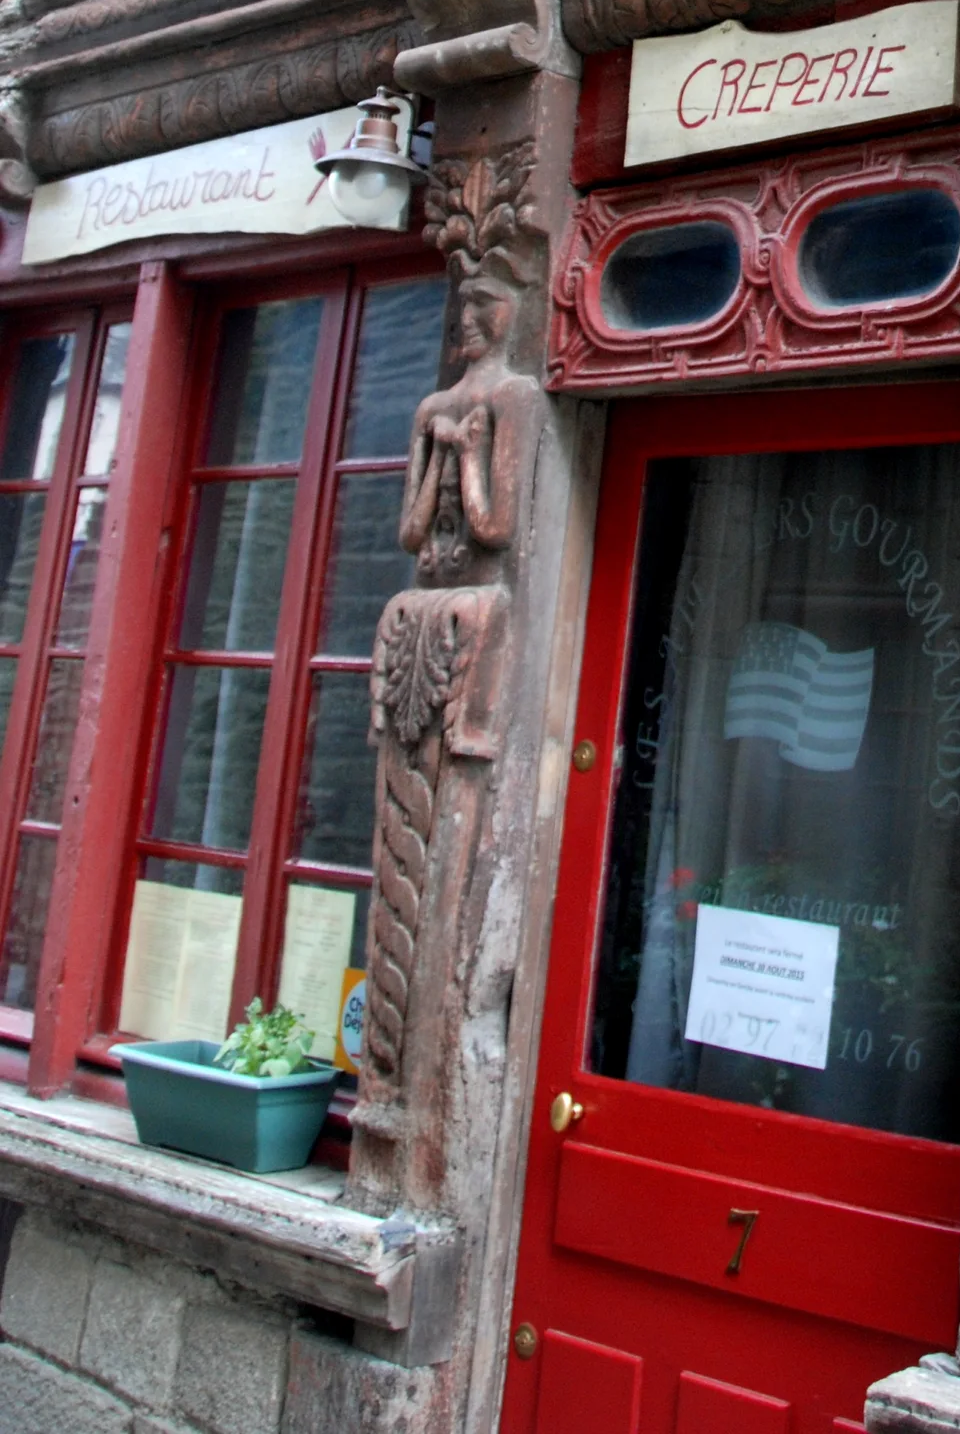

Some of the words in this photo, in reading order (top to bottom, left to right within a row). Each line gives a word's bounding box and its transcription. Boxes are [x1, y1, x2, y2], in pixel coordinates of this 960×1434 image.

[676, 45, 906, 129] CREPERIE
[76, 146, 276, 240] Restaurant
[720, 953, 756, 973] DIMANCHE
[745, 1017, 781, 1053] 97
[837, 1028, 873, 1064] 10
[886, 1034, 925, 1072] 76
[724, 1207, 760, 1277] 7
